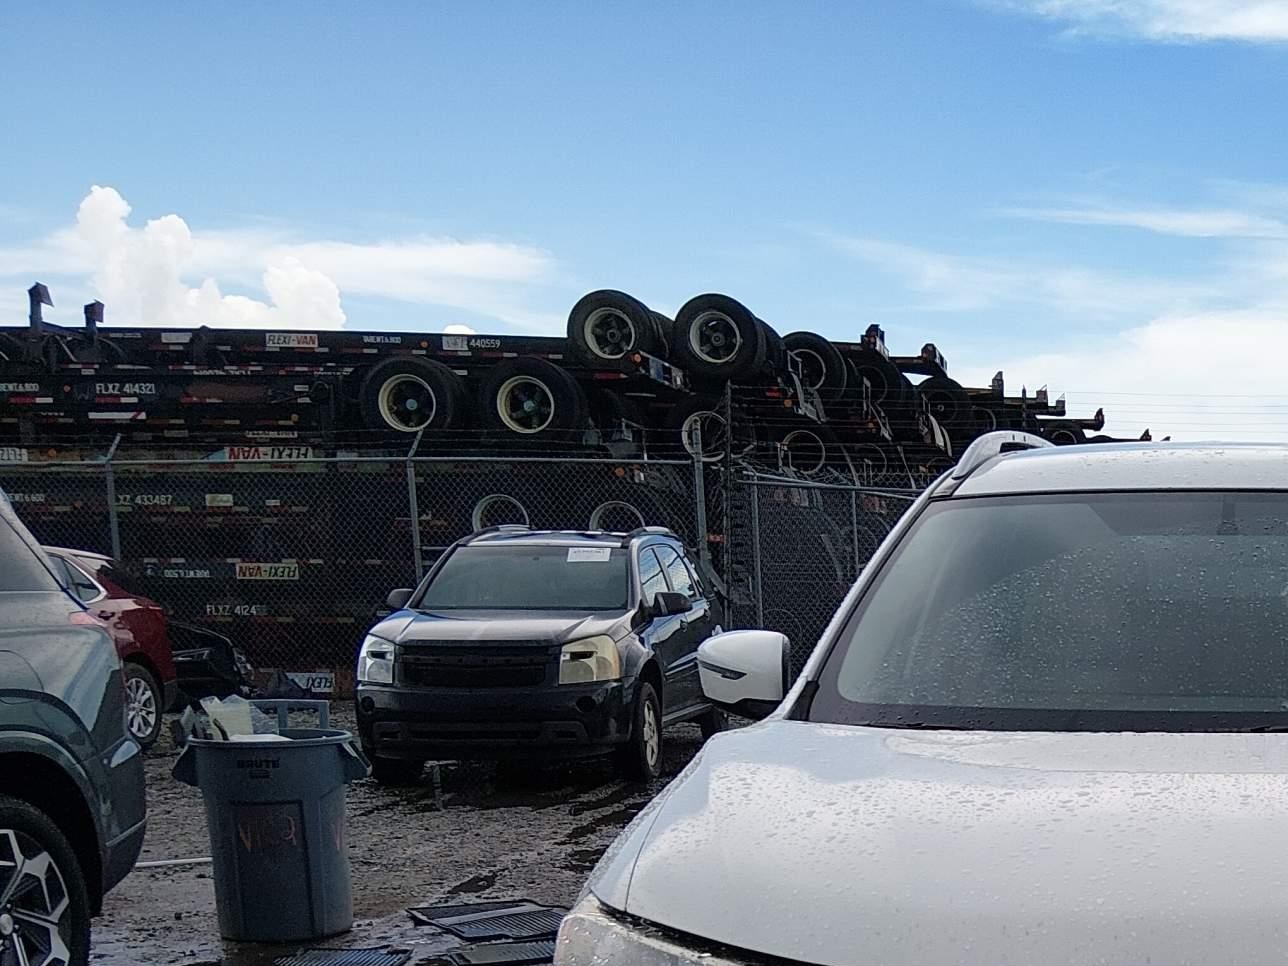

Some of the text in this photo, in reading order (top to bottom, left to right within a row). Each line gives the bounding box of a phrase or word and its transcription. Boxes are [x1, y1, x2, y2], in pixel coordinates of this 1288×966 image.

[268, 335, 317, 346] FLEXI-VAN
[470, 339, 501, 348] 440559
[96, 383, 121, 394] FLXZ
[239, 566, 297, 579] FLEXI-VAN
[206, 605, 230, 615] FLXZ
